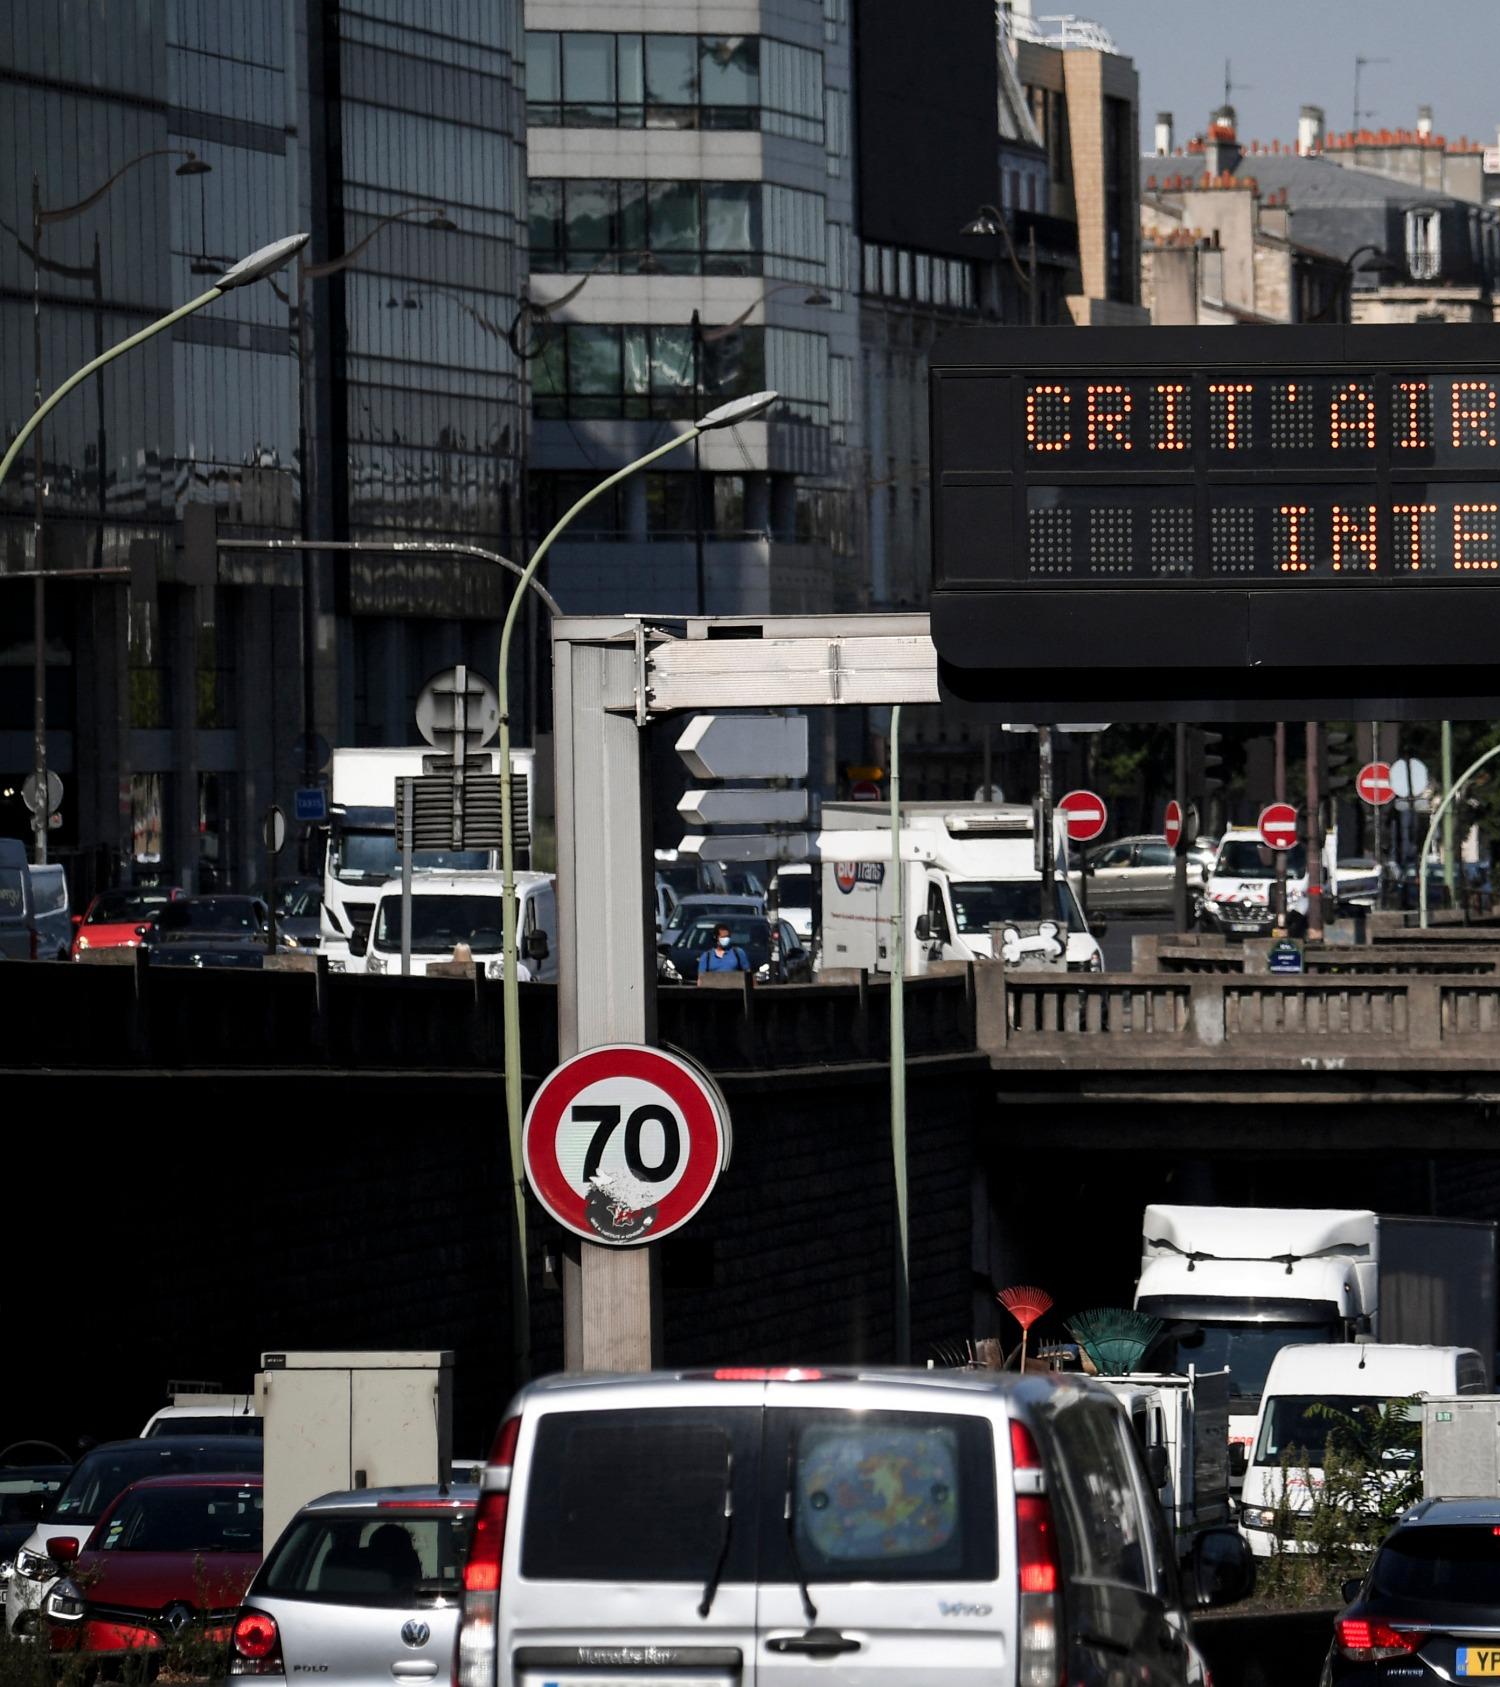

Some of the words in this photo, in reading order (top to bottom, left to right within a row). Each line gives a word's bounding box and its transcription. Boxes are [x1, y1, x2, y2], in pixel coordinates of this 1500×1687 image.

[1024, 382, 1500, 451] CRIT'AIR
[571, 1104, 681, 1183] 70
[293, 1664, 329, 1673] POLO
